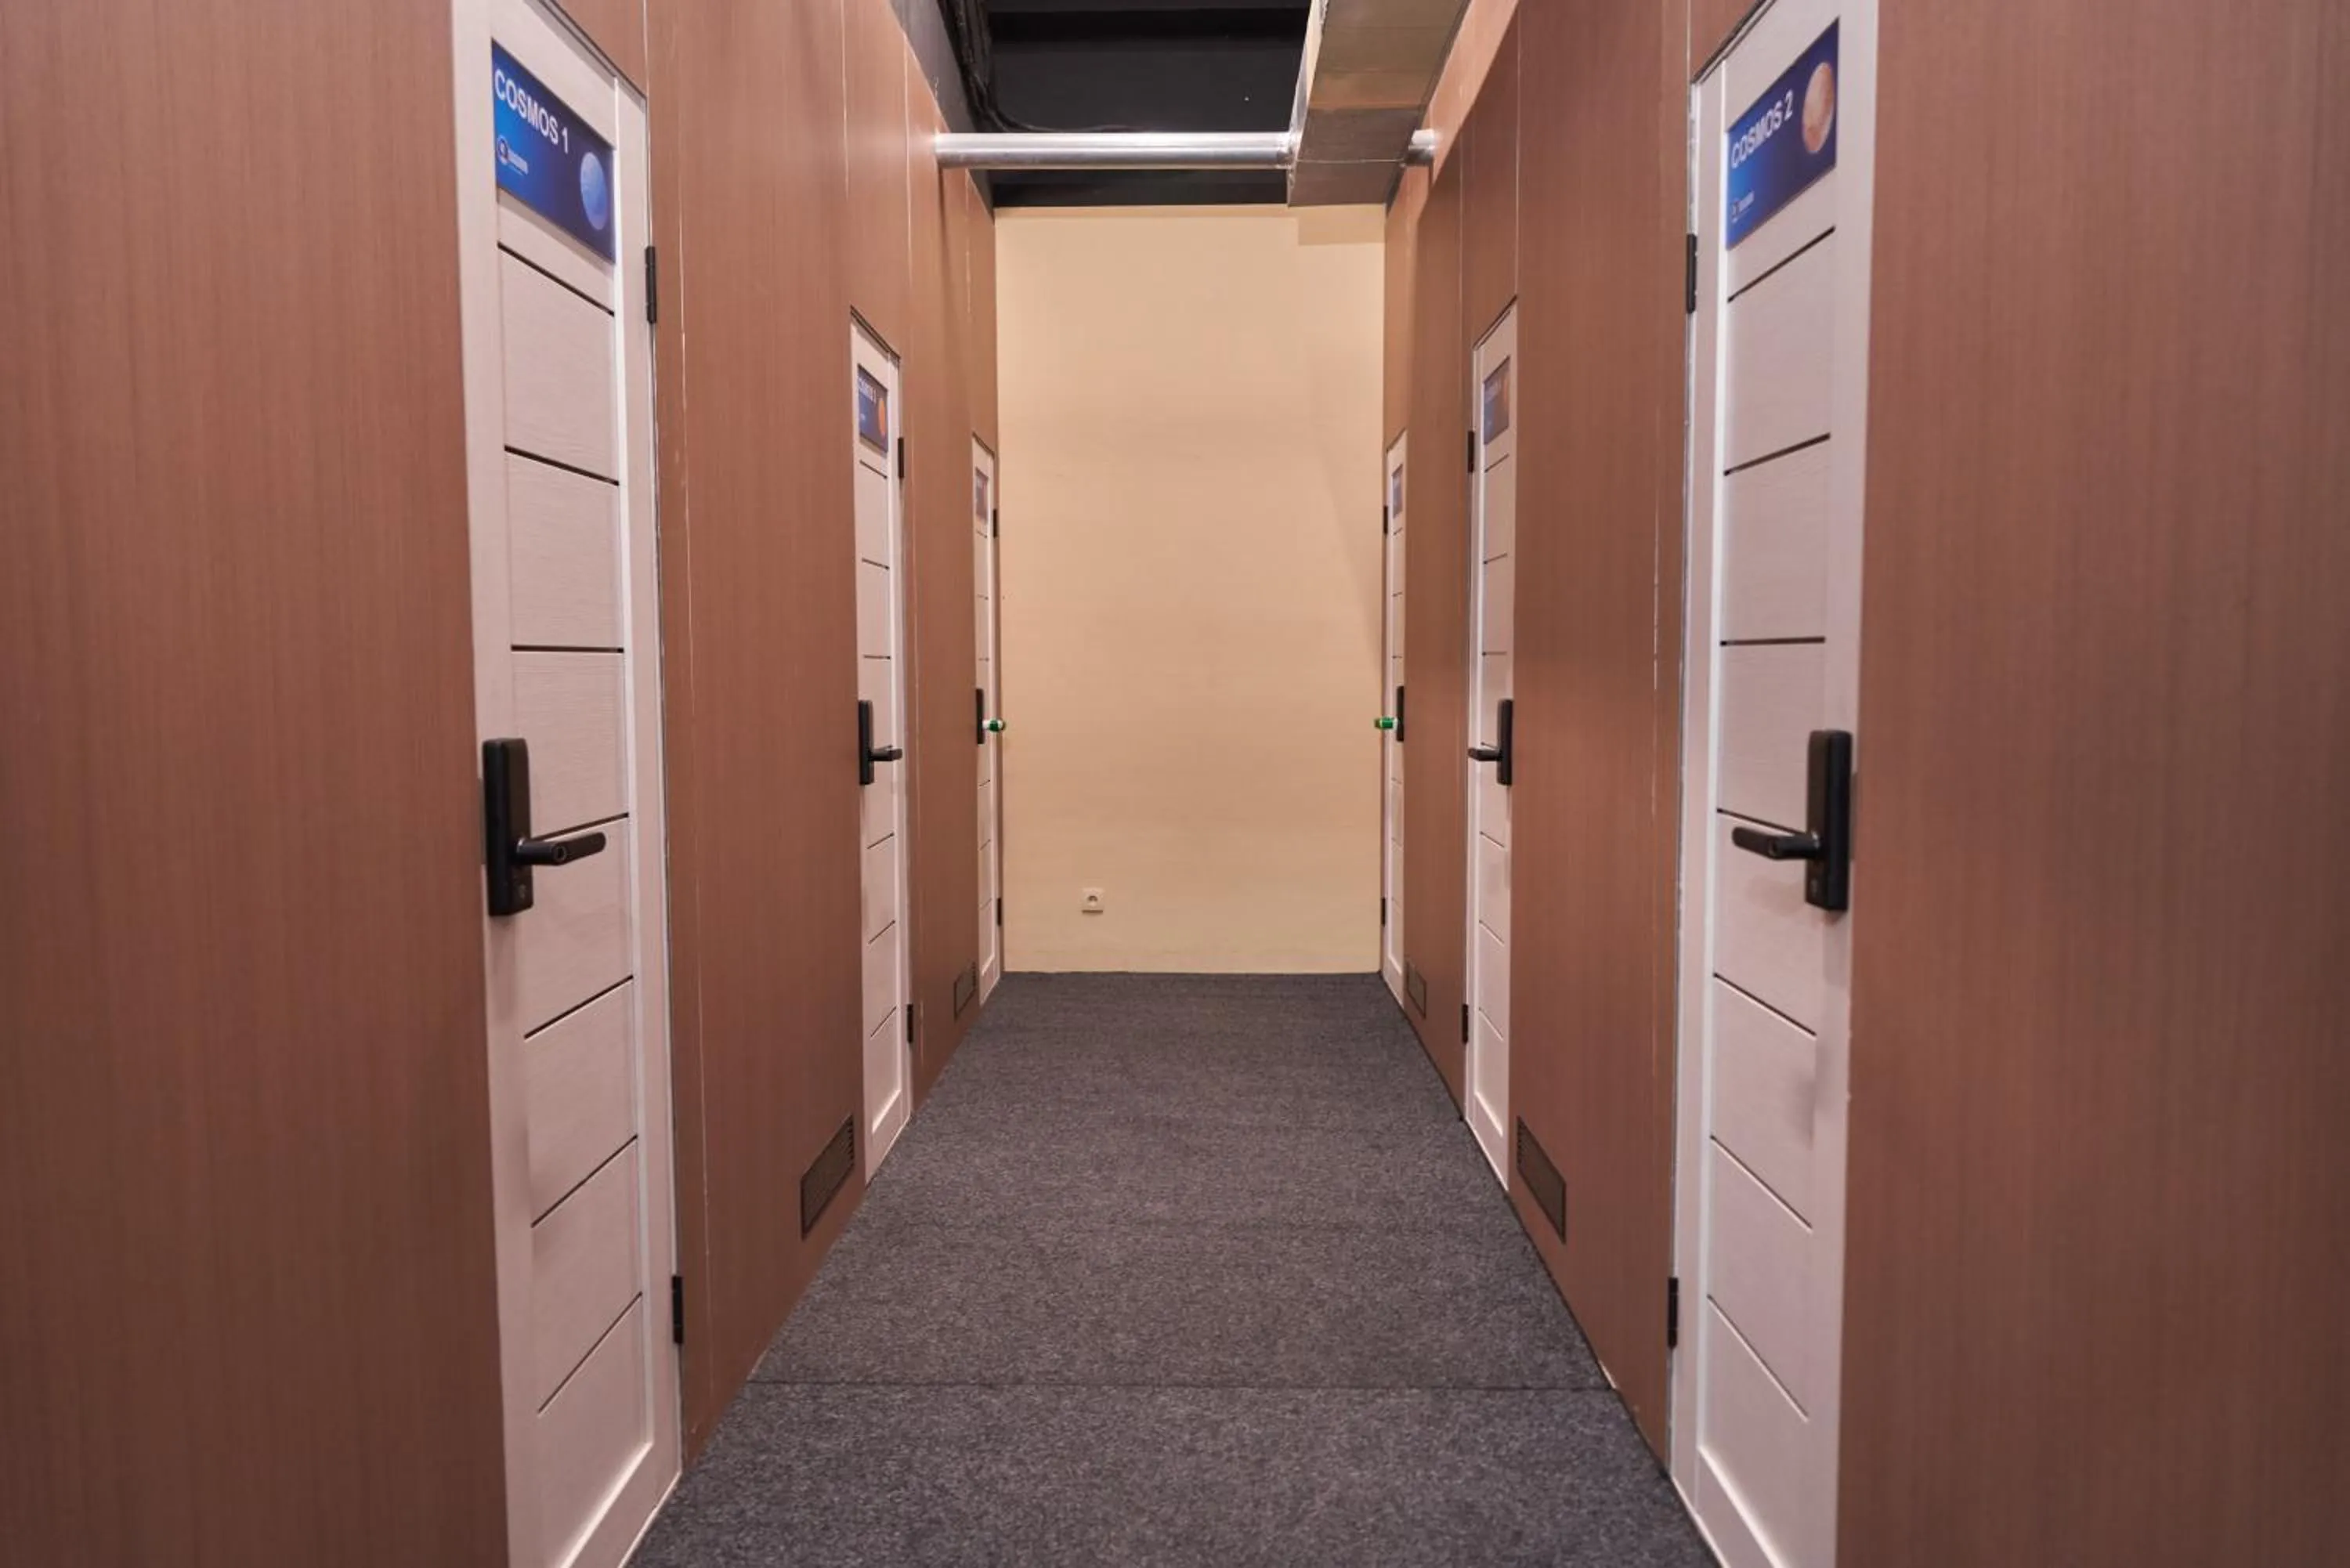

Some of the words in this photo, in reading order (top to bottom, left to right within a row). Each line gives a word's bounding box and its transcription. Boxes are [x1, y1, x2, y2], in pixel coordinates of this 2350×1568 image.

[495, 69, 559, 145] COSMOS
[562, 128, 569, 154] 1
[1730, 101, 1782, 168] COSMOS
[1784, 90, 1794, 121] 2
